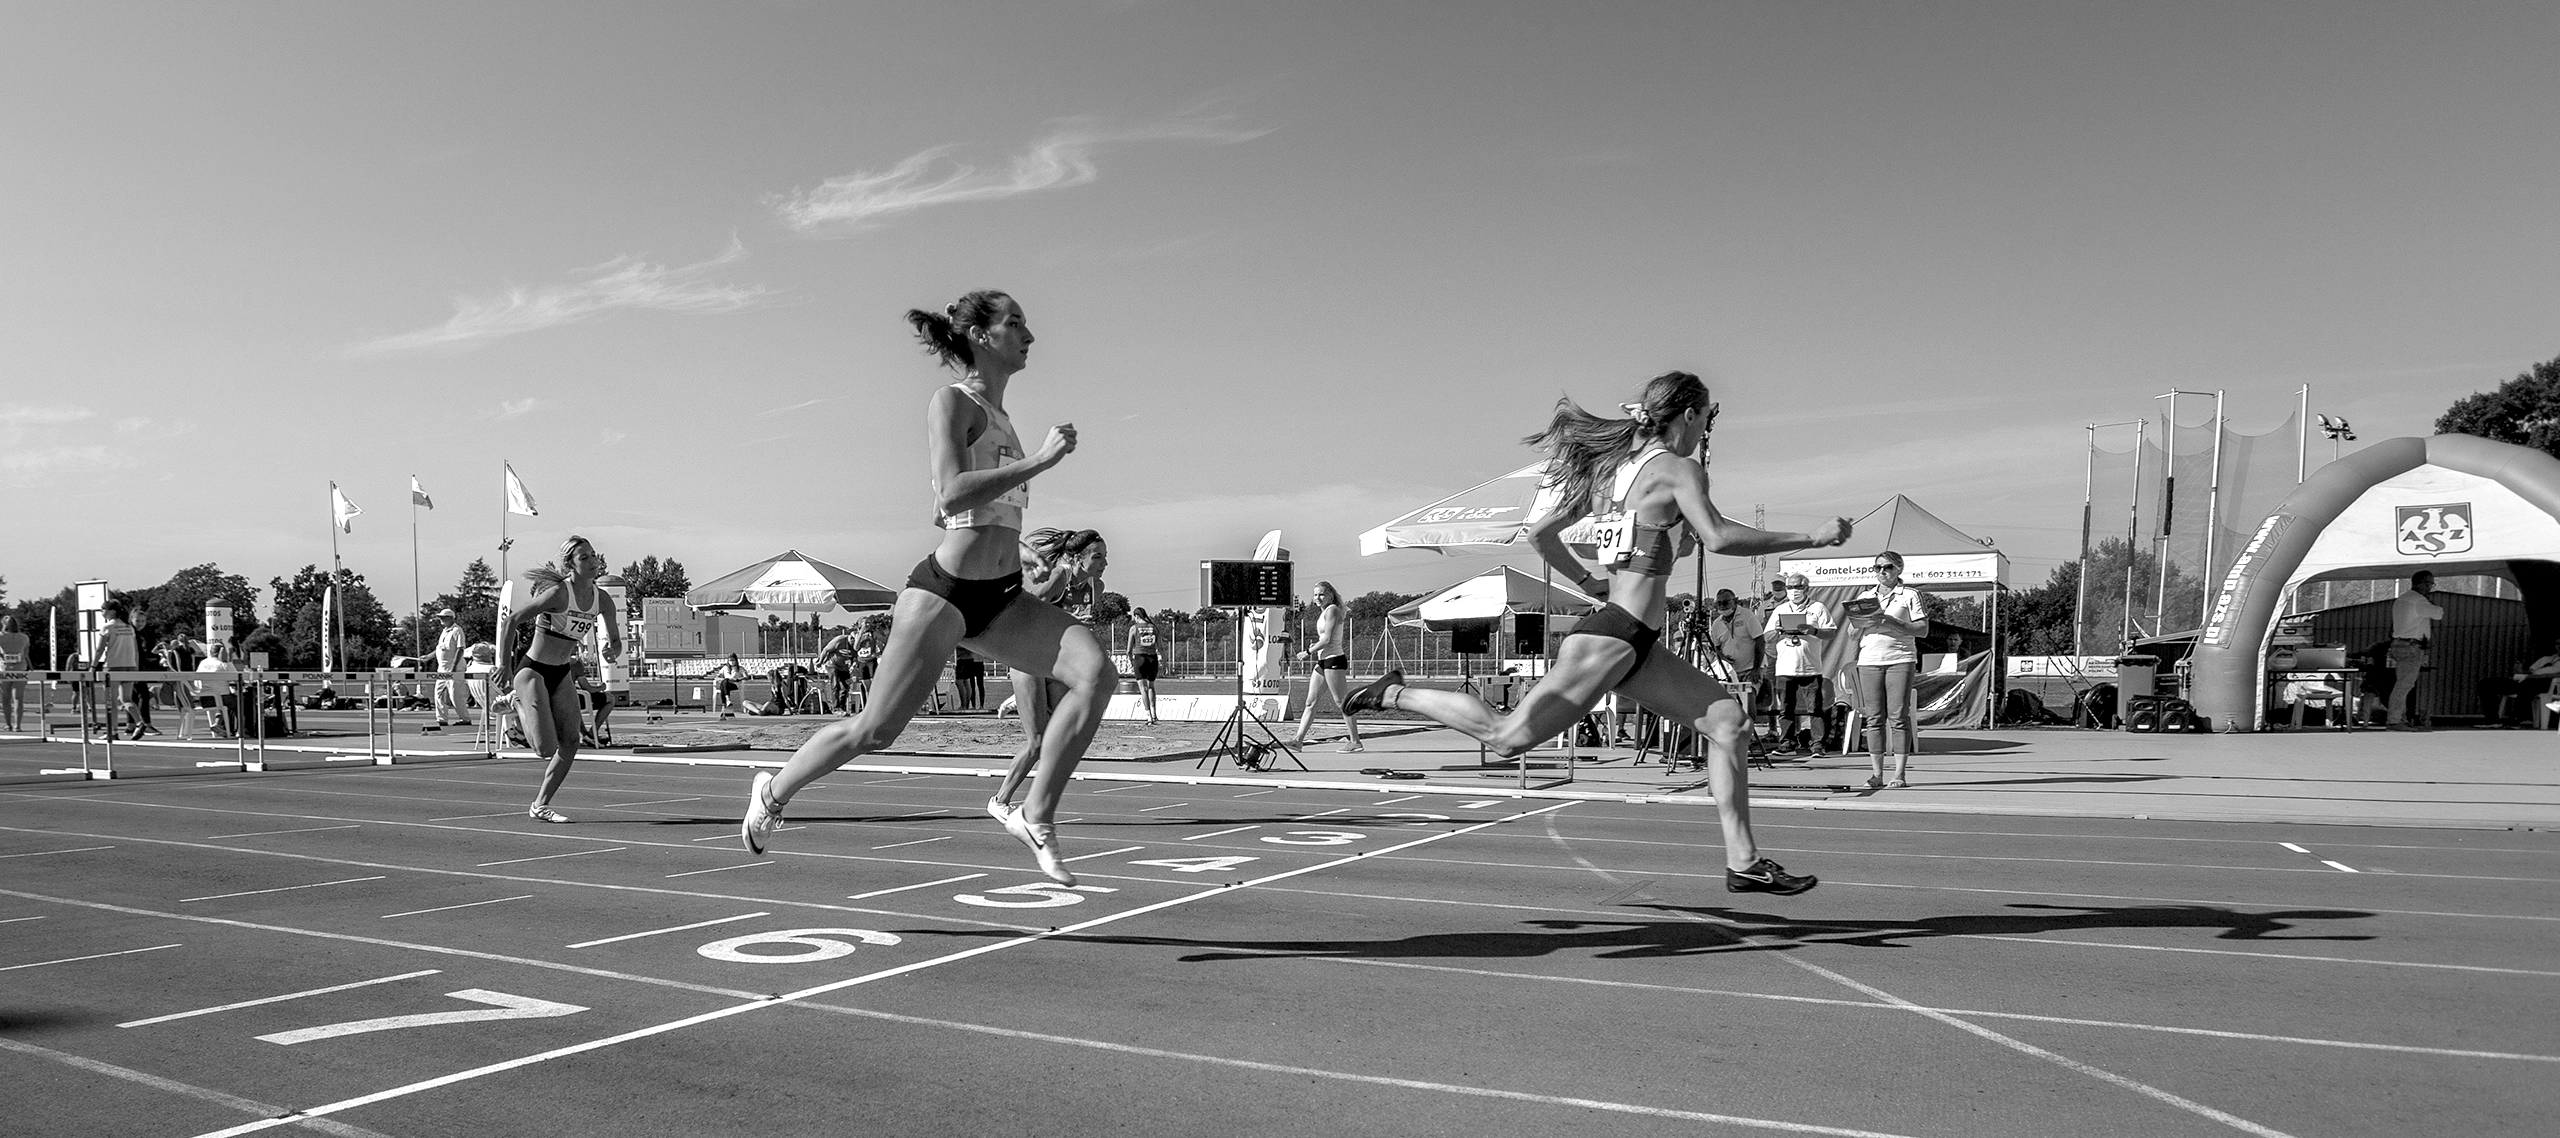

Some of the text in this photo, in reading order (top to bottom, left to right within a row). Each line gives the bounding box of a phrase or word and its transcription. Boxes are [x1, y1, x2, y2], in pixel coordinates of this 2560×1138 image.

[1596, 528, 1622, 549] 691
[1815, 565, 1875, 575] domtel-spo
[2203, 515, 2281, 645] www.amp.azs.pl
[571, 620, 592, 633] 799
[0, 672, 28, 680] LANIK
[1456, 800, 1505, 809] 1
[1260, 831, 1367, 846] 3
[1127, 856, 1262, 873] 4
[953, 882, 1120, 908] 5
[696, 928, 902, 964] 6
[252, 988, 591, 1045] 7
